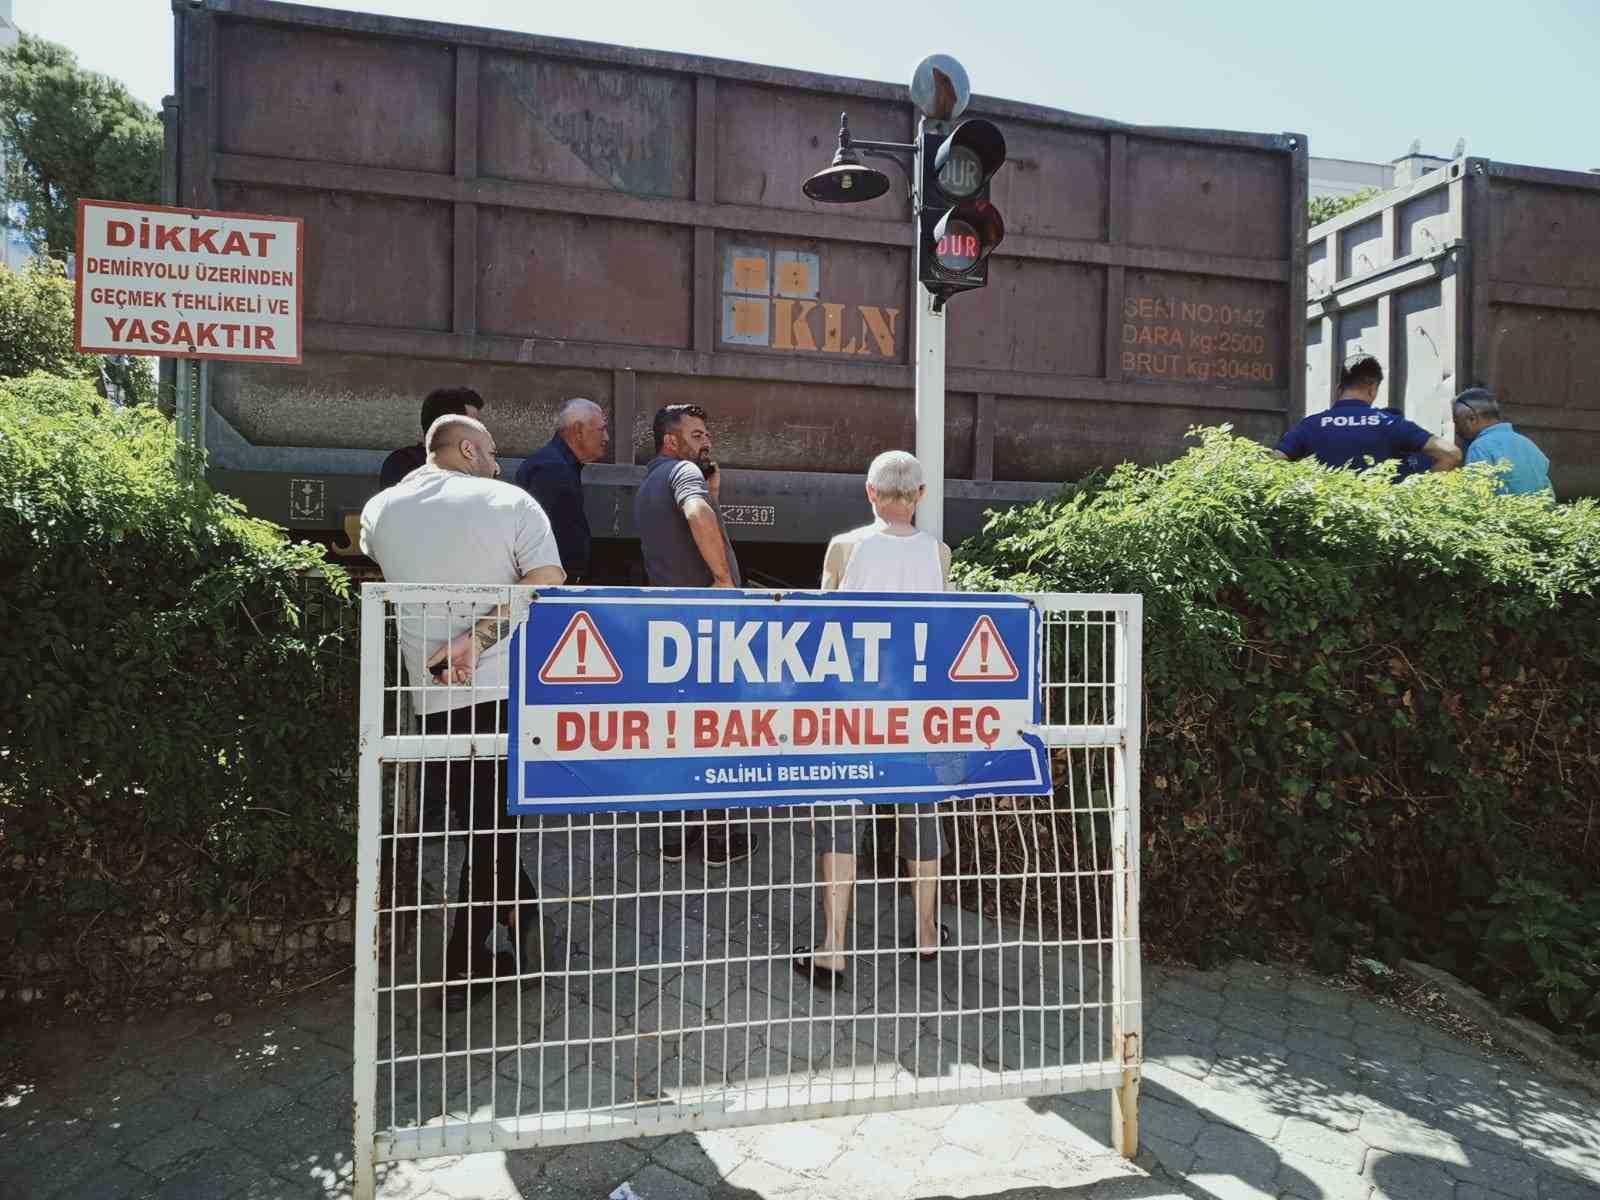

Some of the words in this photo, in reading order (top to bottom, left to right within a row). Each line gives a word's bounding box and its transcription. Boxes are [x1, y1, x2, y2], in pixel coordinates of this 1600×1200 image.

[107, 217, 276, 257] DİKKAT
[936, 235, 975, 256] DUR
[87, 257, 189, 280] DEMİRYOLU
[196, 262, 293, 287] ÜZERİNDEN
[91, 288, 166, 310] GEÇMEK
[172, 292, 261, 314] TEHLİKELİ
[268, 299, 289, 315] VE
[105, 317, 276, 350] YASAKTIR
[772, 299, 899, 356] KLN
[1122, 324, 1184, 346] DARA
[1121, 351, 1182, 374] BRUT
[556, 710, 650, 751] DUR
[694, 709, 779, 749] BAK
[923, 706, 1001, 750] GEÇ
[705, 763, 772, 784] SALİHLİ
[777, 761, 874, 782] BELEDİYESİ
